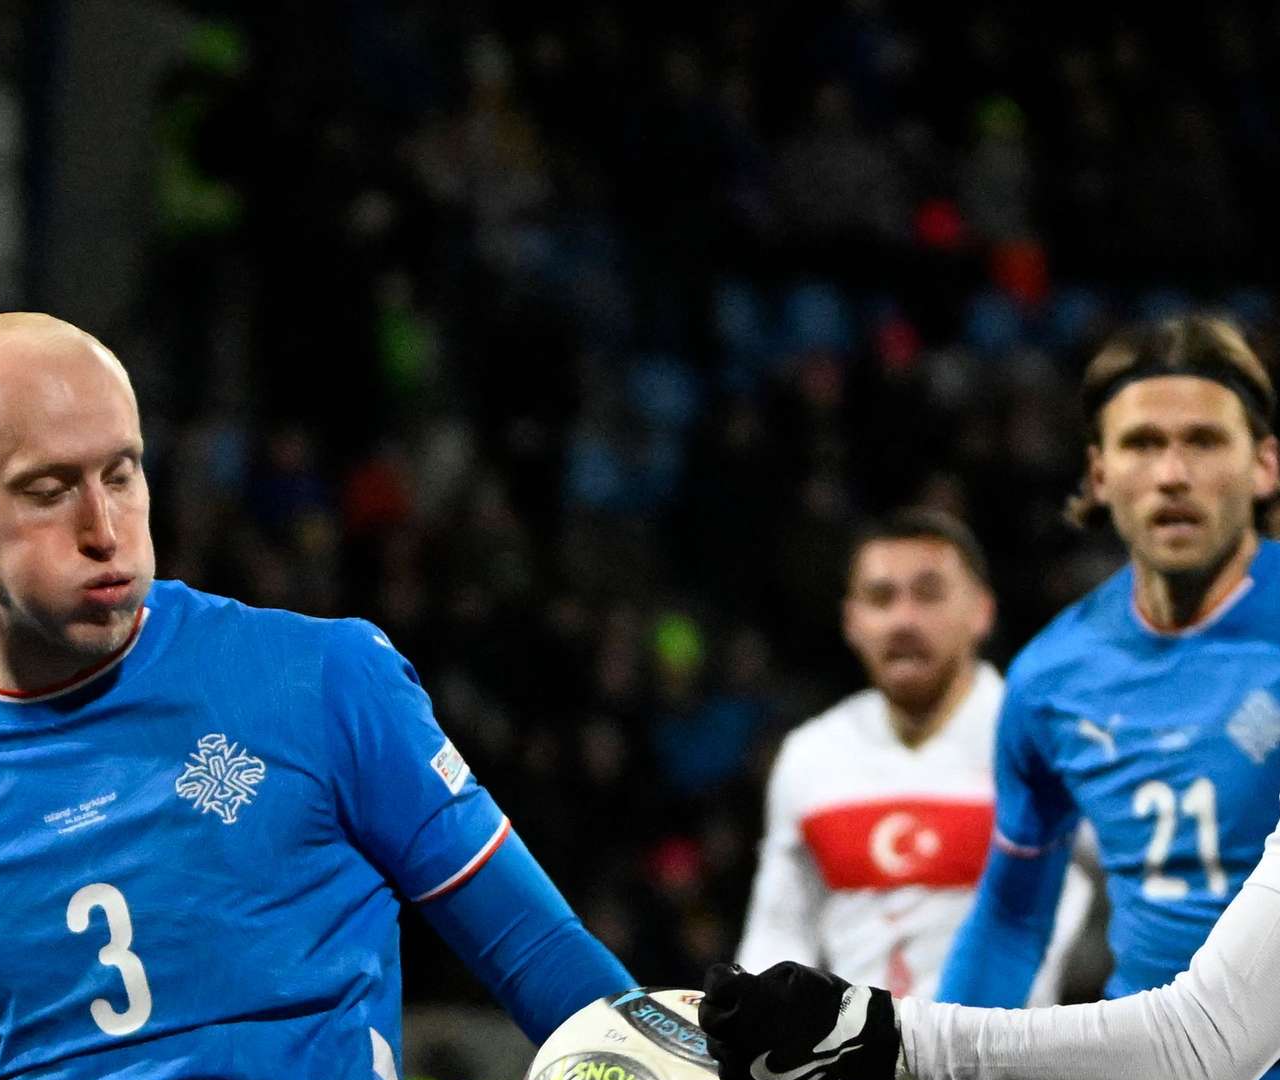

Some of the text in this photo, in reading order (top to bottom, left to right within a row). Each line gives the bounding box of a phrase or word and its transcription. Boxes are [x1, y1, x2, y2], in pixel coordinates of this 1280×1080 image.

[1132, 776, 1229, 901] 21
[66, 883, 152, 1037] 3
[629, 1003, 709, 1057] EAGUE
